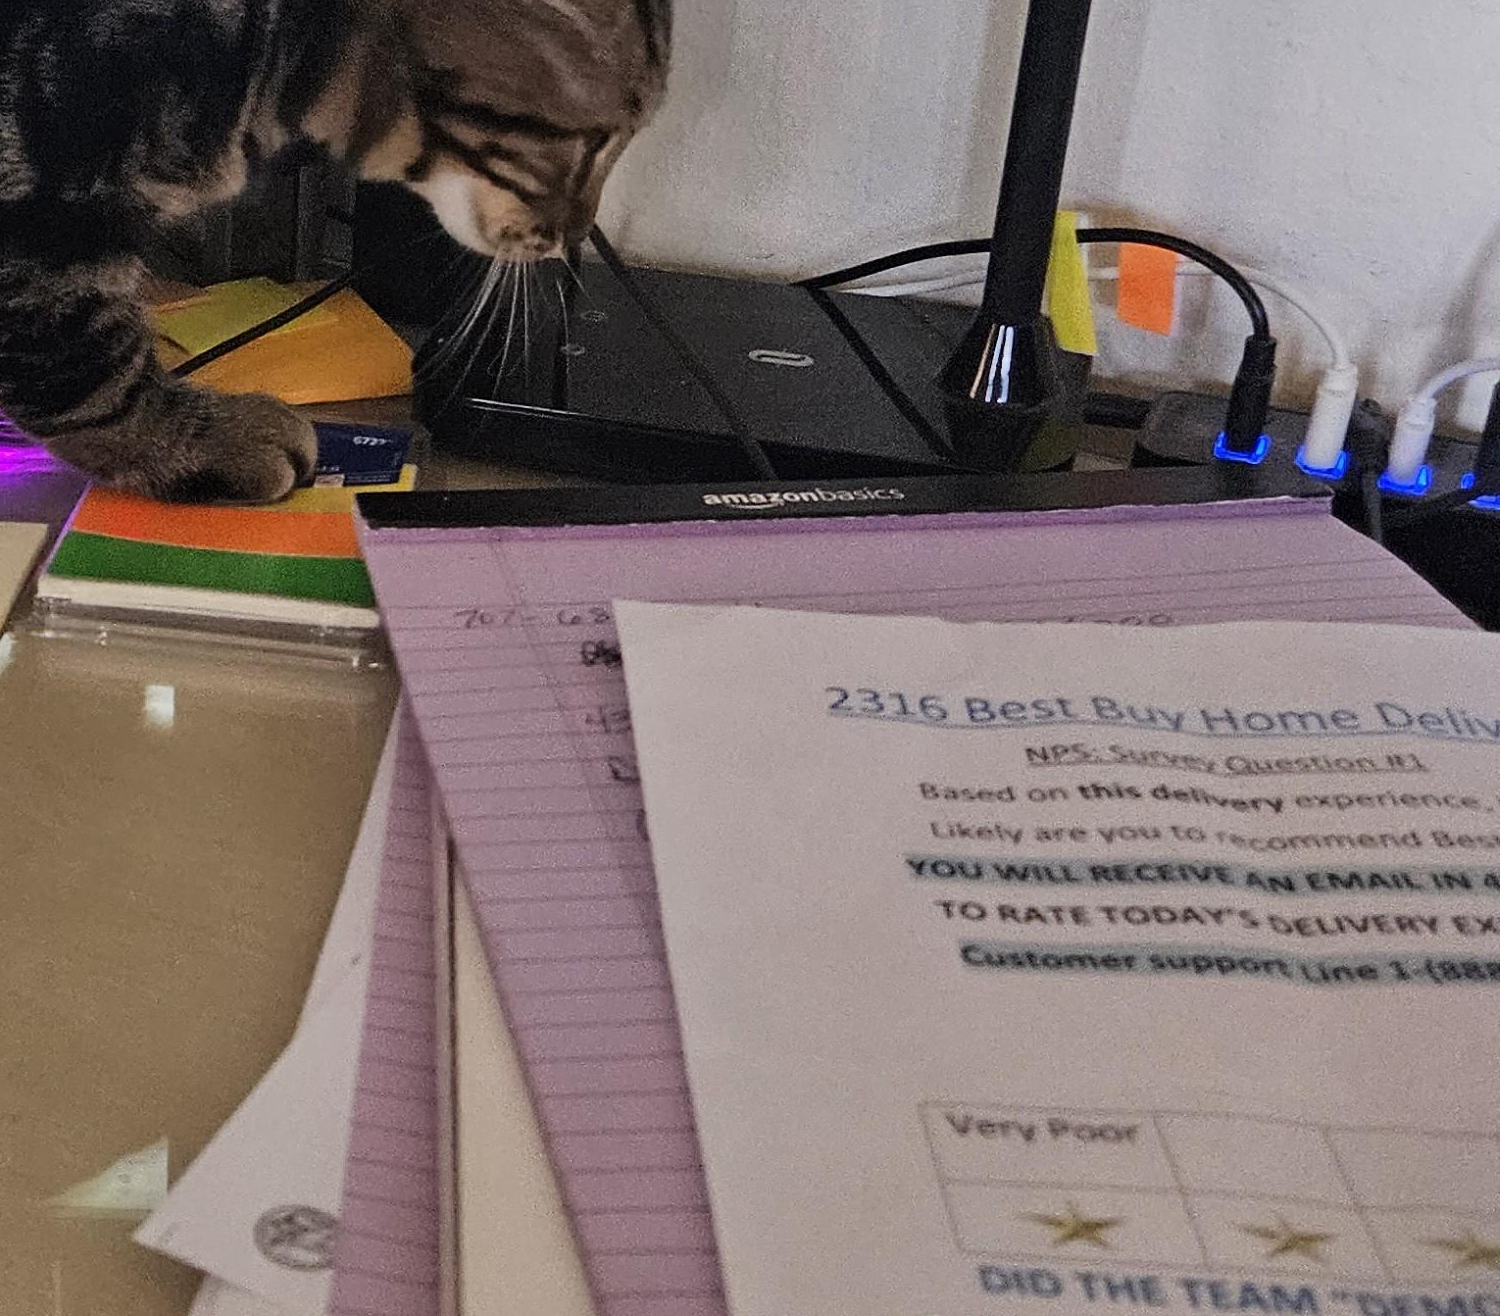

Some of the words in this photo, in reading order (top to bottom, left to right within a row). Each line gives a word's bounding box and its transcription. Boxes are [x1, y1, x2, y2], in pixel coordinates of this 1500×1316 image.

[703, 487, 905, 510] amazonbasics
[825, 686, 948, 722] 2316
[964, 696, 1077, 724] Best
[1092, 696, 1183, 733] Buy
[1200, 707, 1360, 732] Home
[1107, 744, 1216, 774] Survey
[1225, 754, 1376, 775] Question
[919, 782, 1016, 803] Based
[1027, 787, 1069, 803] on
[1076, 782, 1142, 801] this
[1149, 784, 1283, 814] delivery
[929, 821, 1023, 845] Likely
[1035, 826, 1087, 843] are
[1096, 826, 1162, 844] you
[1169, 825, 1206, 844] to
[1216, 830, 1423, 852] recommend
[904, 858, 983, 880] YOU
[993, 862, 1078, 883] WILL
[1090, 861, 1236, 884] RECEIVE
[1246, 869, 1296, 892] AN
[1304, 871, 1425, 891] EMAIL
[1431, 871, 1473, 890] IN
[933, 900, 988, 922] TO
[996, 904, 1091, 926] RATE
[1100, 904, 1261, 929] TODAY'S
[1267, 913, 1439, 936] DELIVERY
[1451, 914, 1500, 936] EX
[960, 943, 1136, 969] Customer
[1149, 953, 1295, 978] support
[945, 1114, 1036, 1143] Very
[1046, 1117, 1139, 1144] Poor
[977, 1264, 1063, 1299] DID
[1074, 1269, 1168, 1308] THE
[1177, 1277, 1319, 1316] TEAM
